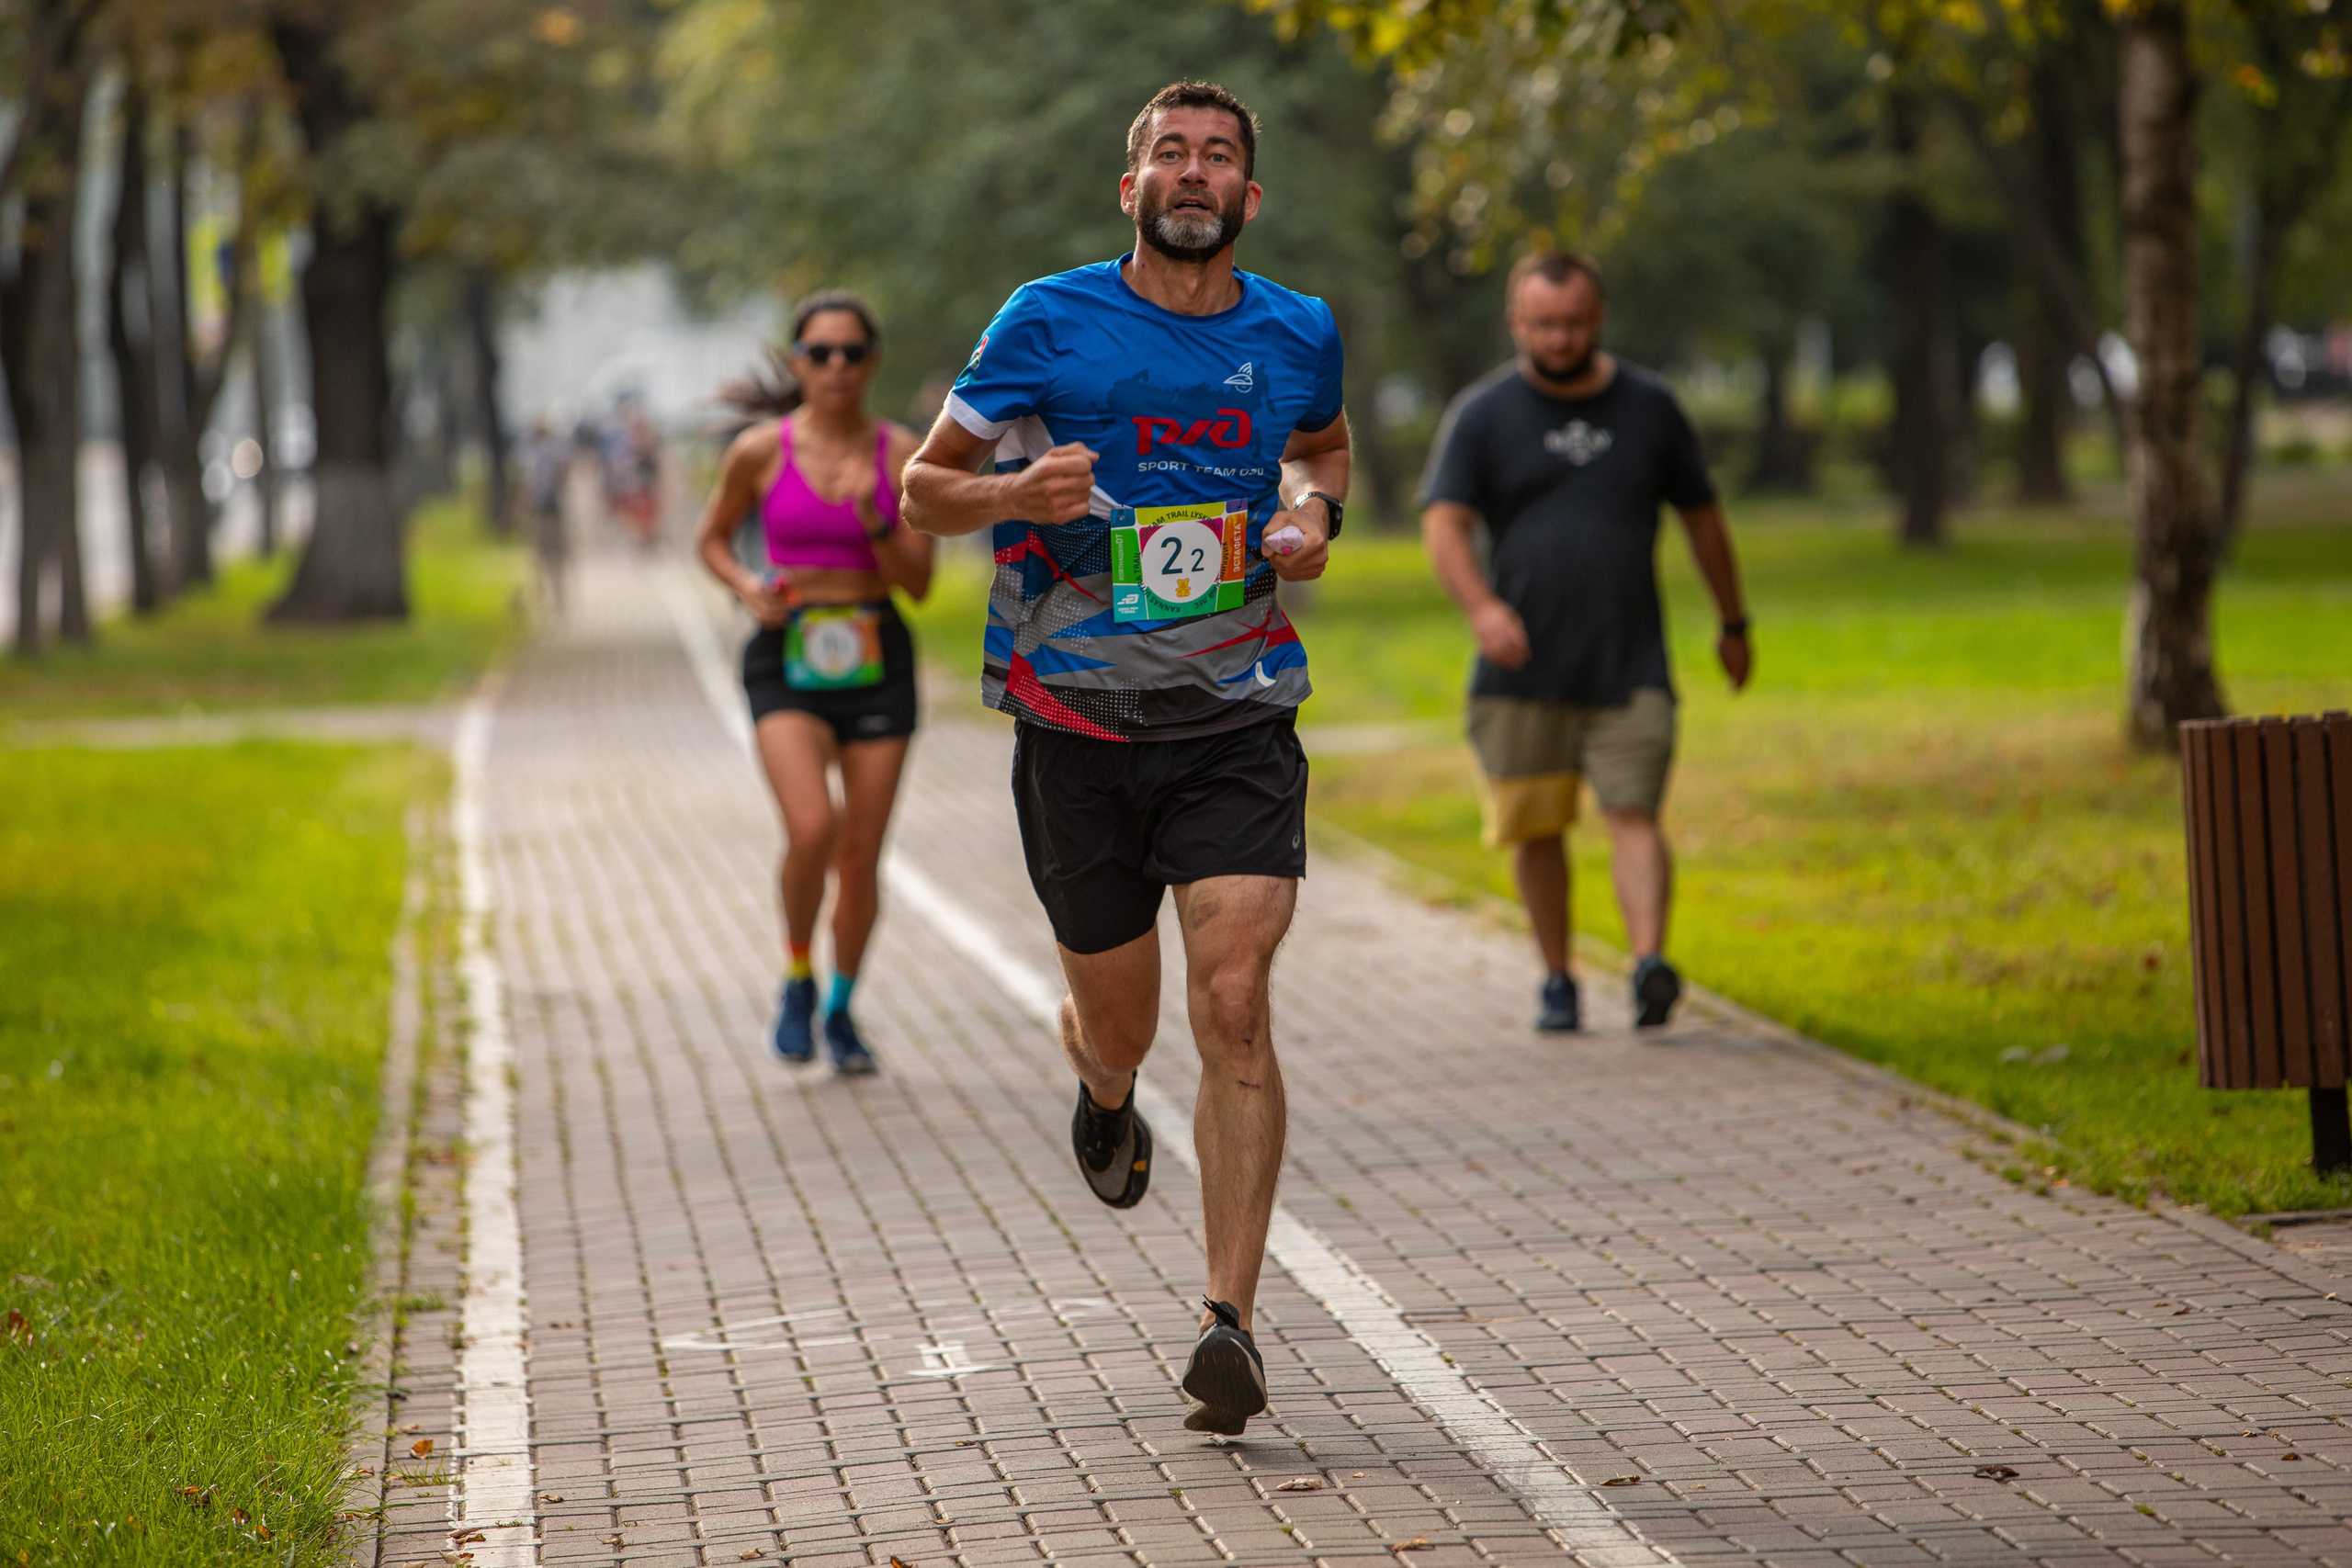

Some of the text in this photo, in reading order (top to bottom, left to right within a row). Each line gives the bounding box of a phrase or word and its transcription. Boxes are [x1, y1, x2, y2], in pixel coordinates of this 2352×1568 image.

[1137, 460, 1190, 472] SPORT
[1193, 465, 1236, 477] TEAM
[1140, 510, 1220, 540] DREAM TRAIL LYSKOVO
[1233, 523, 1242, 573] ЭСТАФЕТА
[1133, 551, 1141, 574] TRAIL
[1149, 596, 1181, 613] KANNAS
[1193, 596, 1208, 609] ЛЕС
